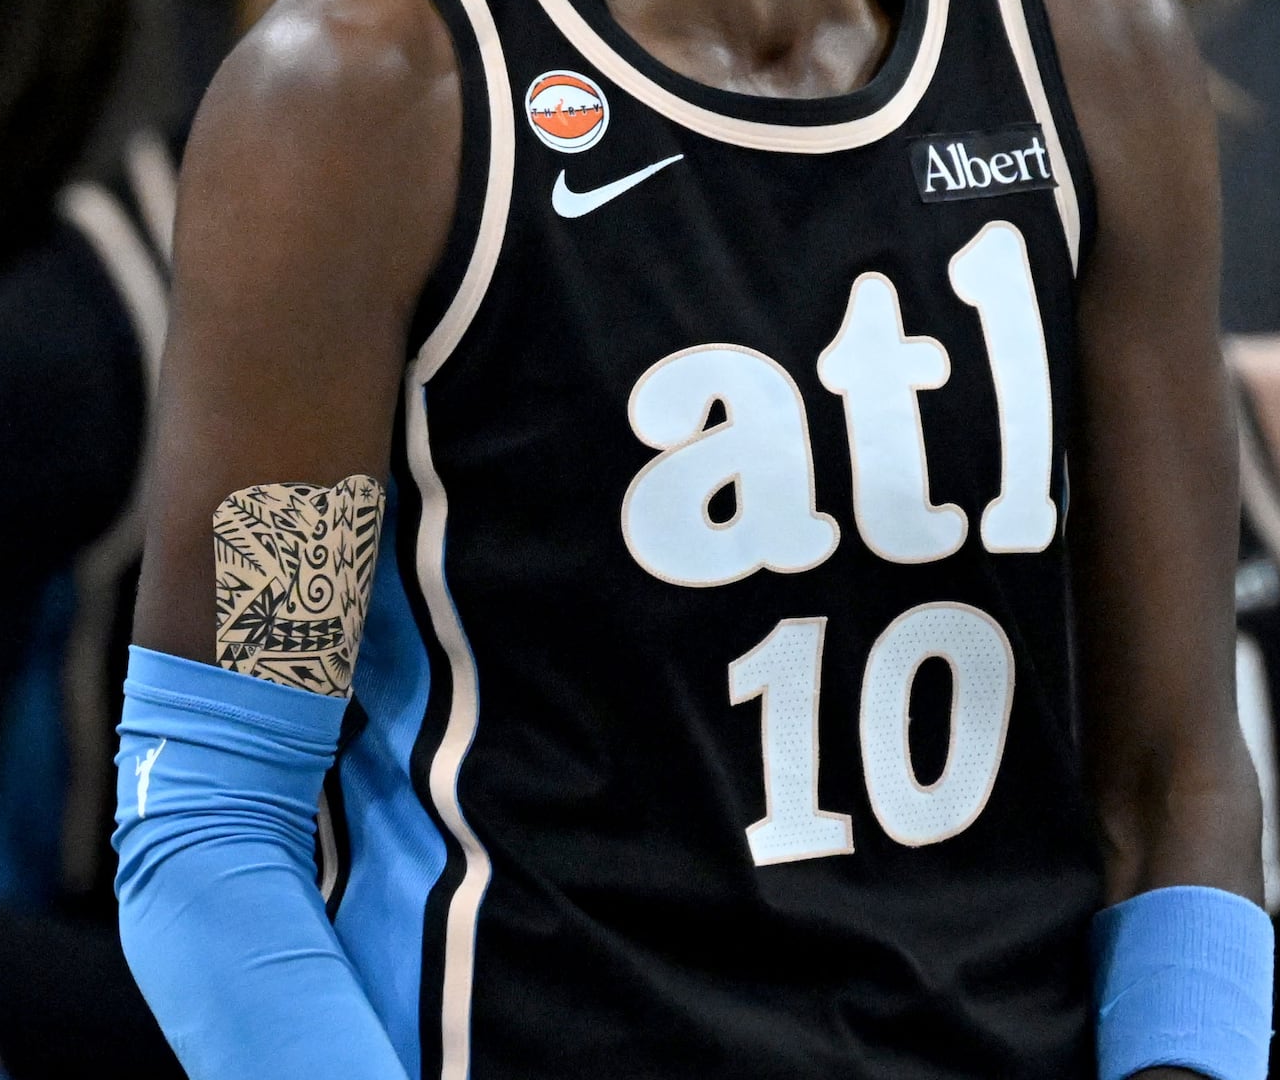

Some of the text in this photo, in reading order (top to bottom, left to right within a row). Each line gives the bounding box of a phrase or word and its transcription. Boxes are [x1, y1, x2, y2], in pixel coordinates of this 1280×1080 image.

[924, 136, 1051, 193] Albert
[620, 219, 1058, 588] atl
[727, 601, 1016, 867] 10
